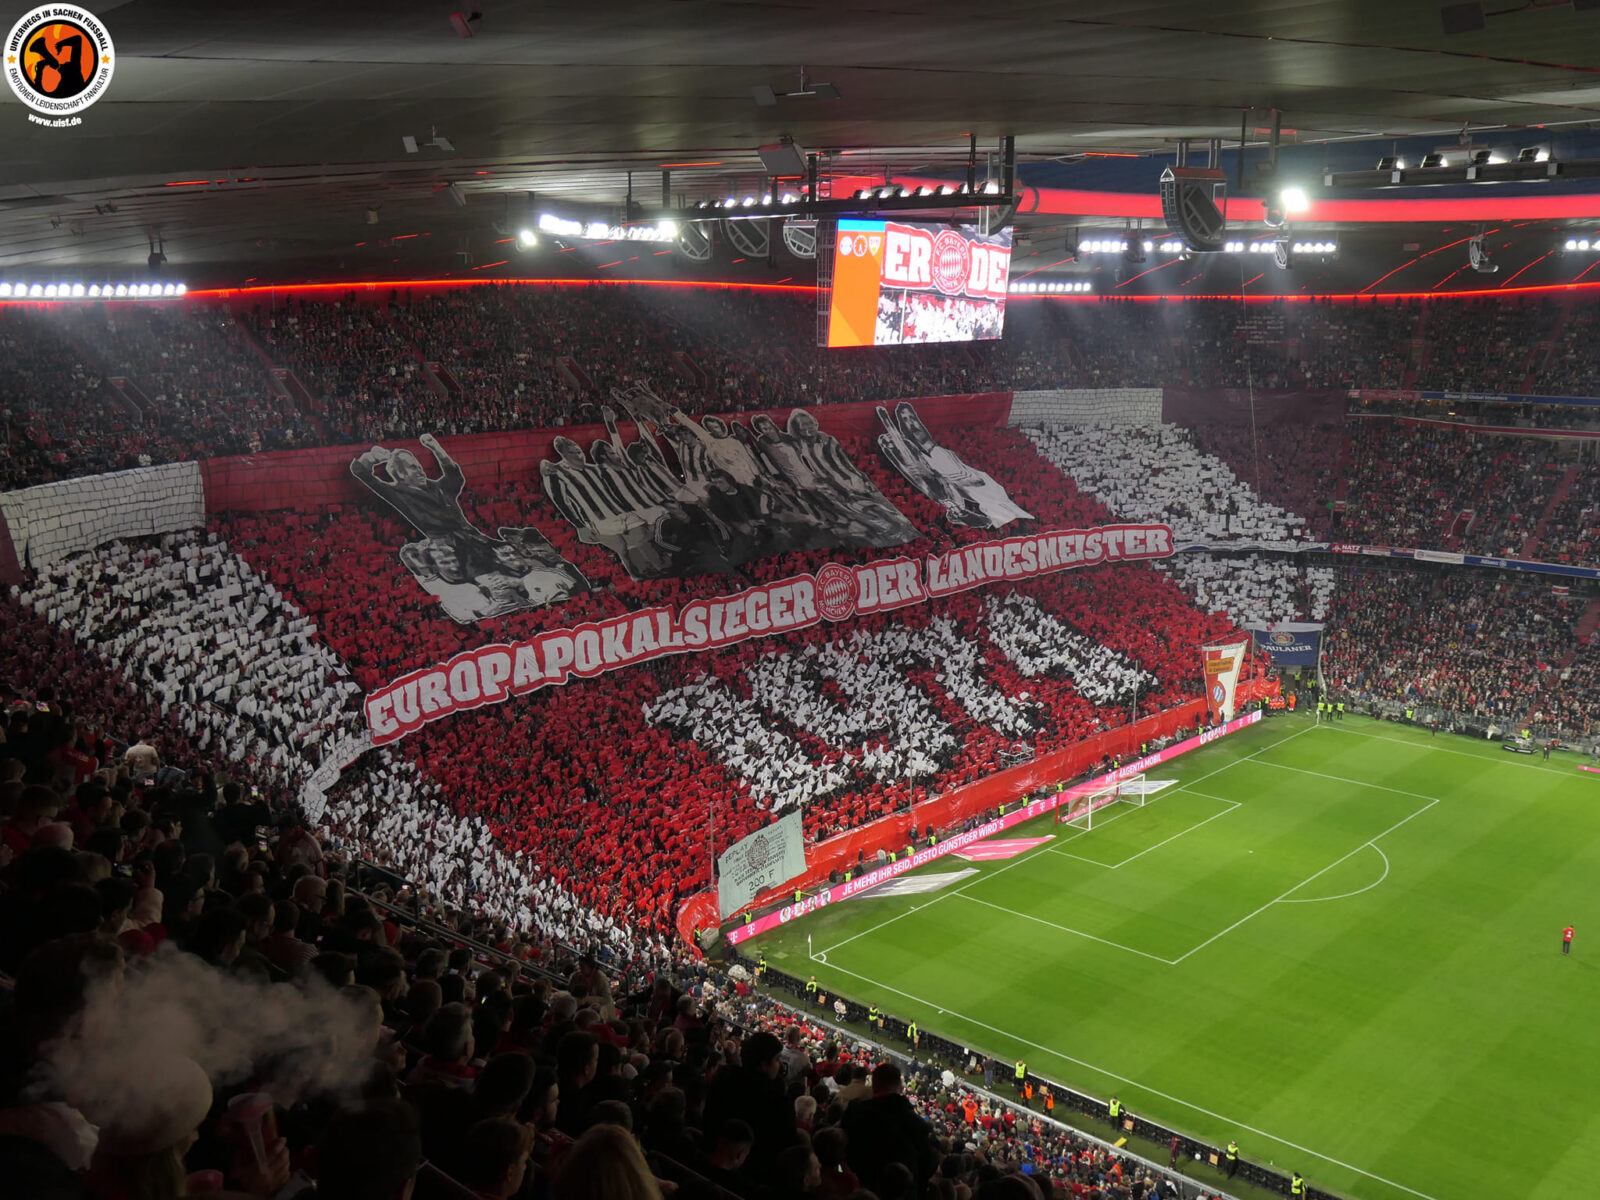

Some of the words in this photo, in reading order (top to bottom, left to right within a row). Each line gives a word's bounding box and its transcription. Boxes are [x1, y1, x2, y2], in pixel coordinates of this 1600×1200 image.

[885, 231, 931, 283] ER
[367, 575, 817, 737] EUROPAPOKALSIEGER
[857, 561, 923, 608] DER
[928, 528, 1170, 590] LANDESMEISTER
[1262, 644, 1312, 652] PAULANER
[1144, 753, 1162, 768] MOBIL
[842, 883, 853, 896] JE
[853, 872, 878, 891] MEHR
[878, 864, 893, 879] IHR
[893, 857, 913, 875] SEID,
[913, 848, 938, 867] DESTO
